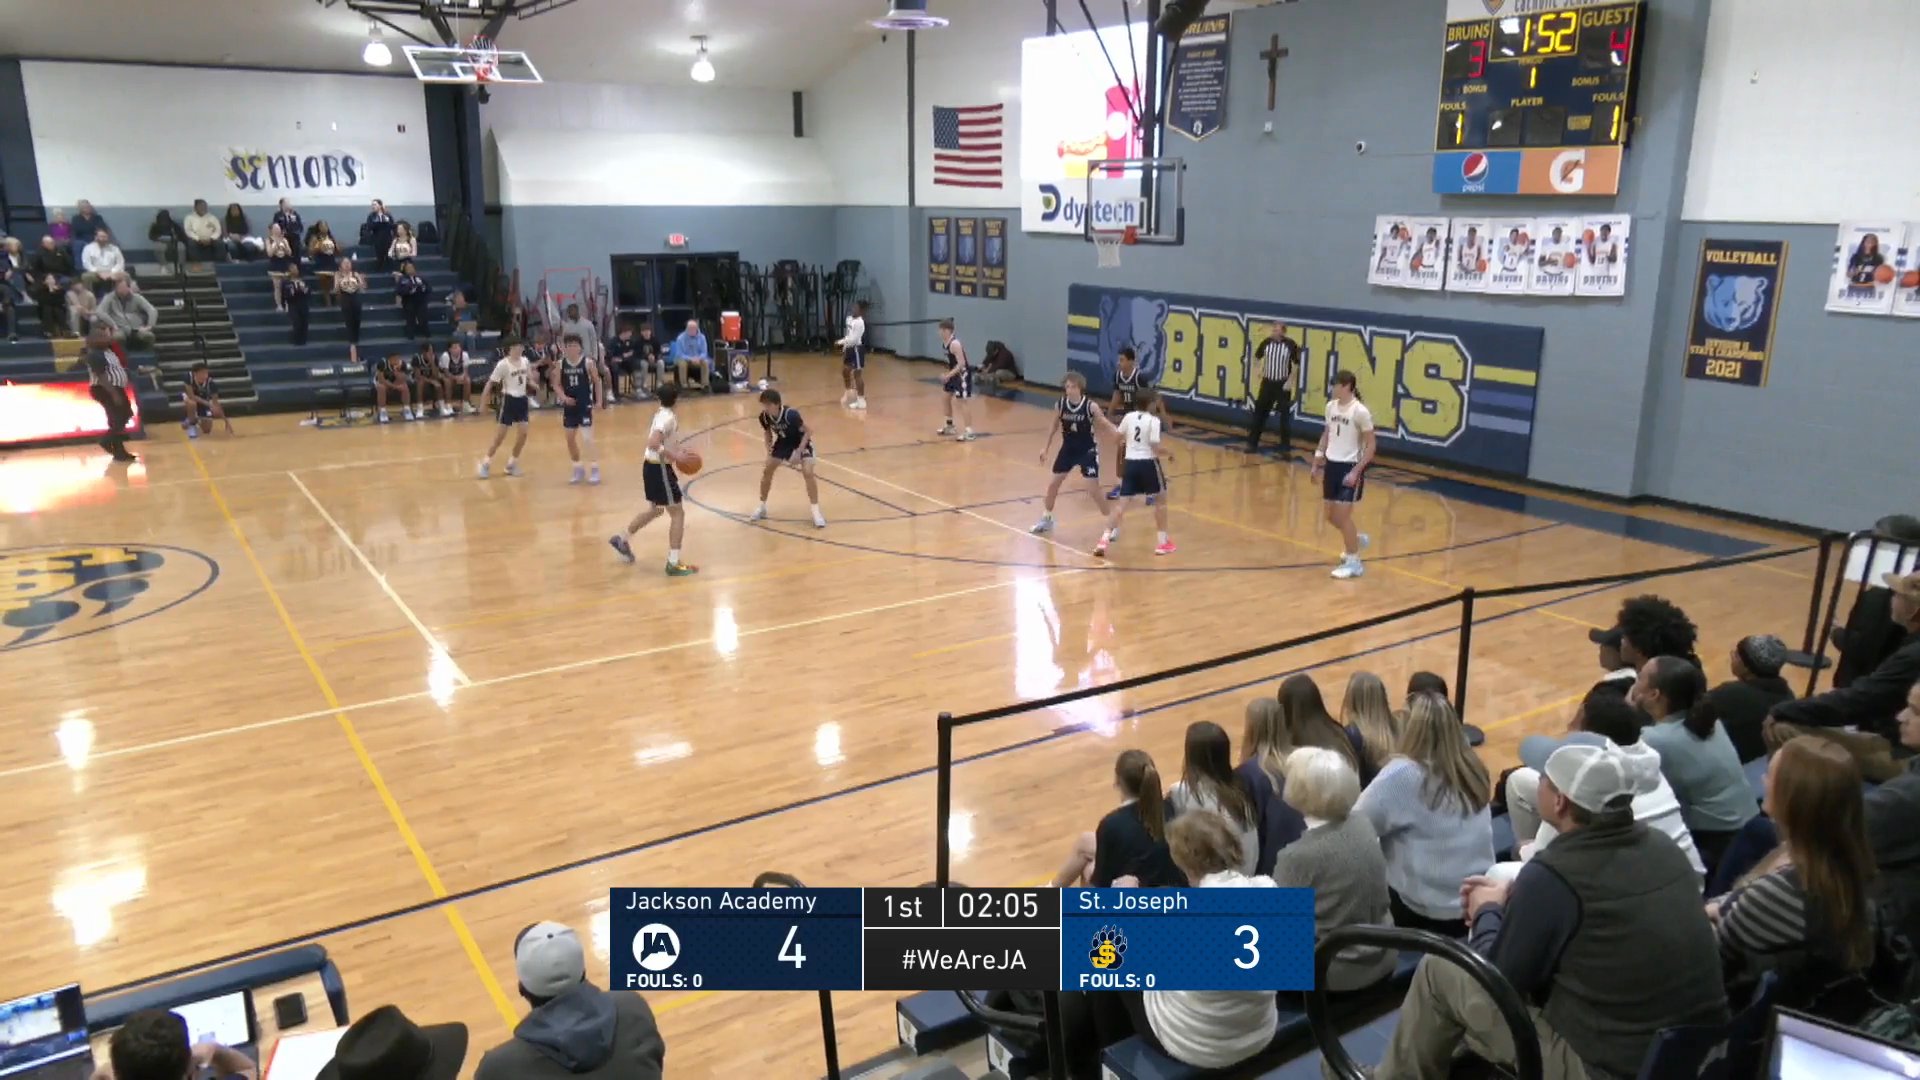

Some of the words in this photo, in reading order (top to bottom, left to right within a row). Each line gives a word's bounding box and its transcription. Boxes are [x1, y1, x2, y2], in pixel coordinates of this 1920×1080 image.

[1582, 8, 1633, 27] GUEST
[1448, 24, 1490, 41] BRUINS
[1523, 12, 1576, 53] 1:52
[1609, 28, 1632, 64] 4
[1468, 40, 1487, 77] 3
[1530, 67, 1537, 88] 1
[1511, 97, 1543, 107] PLAYER
[1592, 92, 1625, 102] FOULS
[1456, 113, 1464, 144] 1
[1610, 105, 1620, 140] 1
[1549, 149, 1585, 193] G
[1706, 250, 1777, 265] VOLLEYBALL
[1158, 306, 1469, 444] BRUINS
[1705, 359, 1742, 378] 2021
[1134, 426, 1141, 442] 2
